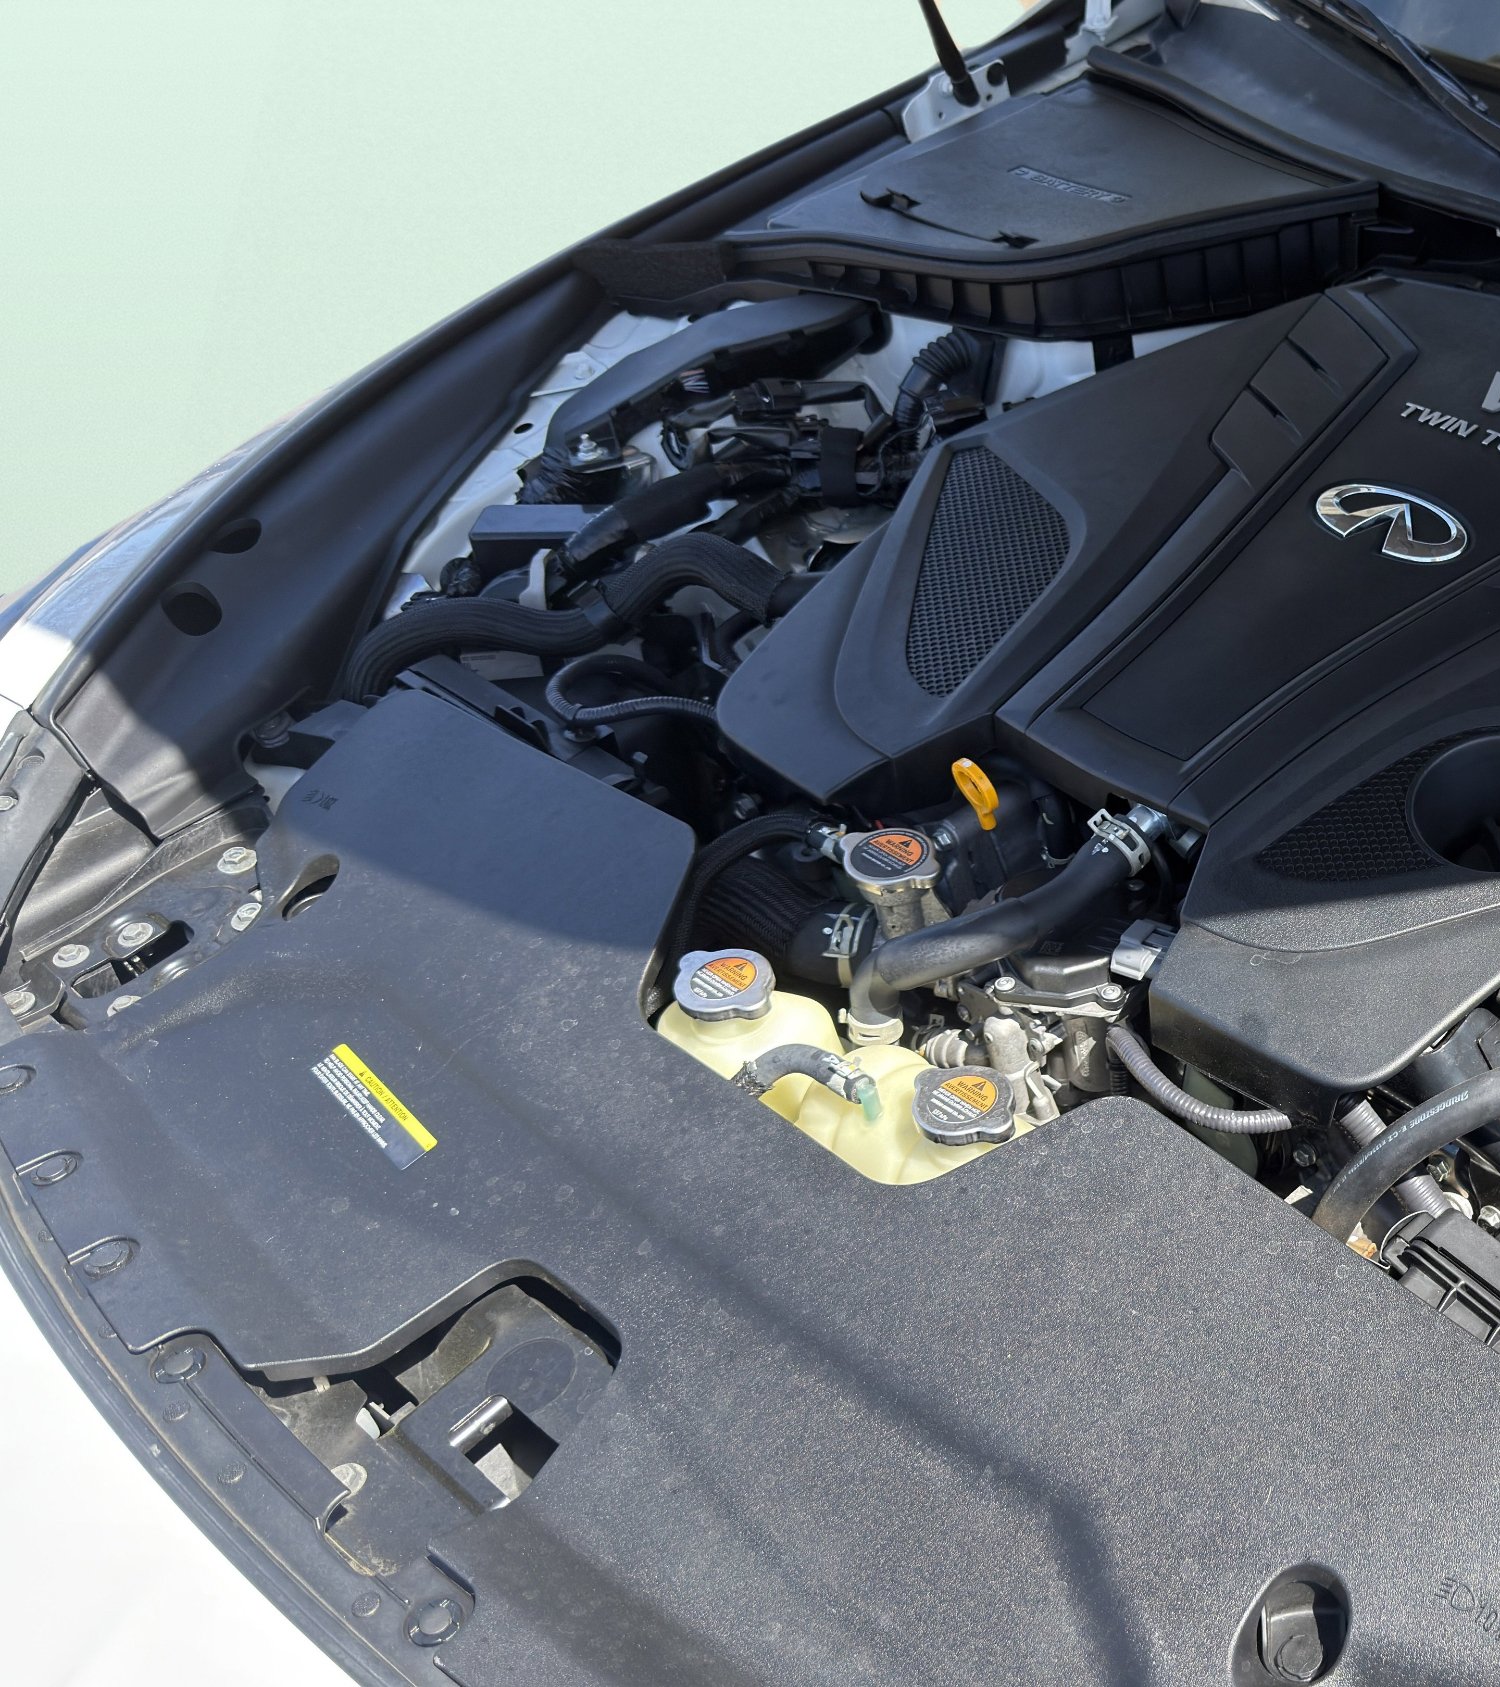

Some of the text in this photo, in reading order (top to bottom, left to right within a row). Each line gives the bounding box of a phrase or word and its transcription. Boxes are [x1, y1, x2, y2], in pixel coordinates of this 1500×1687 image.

[1031, 174, 1108, 200] BATTERY
[1400, 402, 1480, 438] TWIN
[872, 839, 914, 863] AVERTISSEMENT
[885, 838, 913, 856] WARNING
[720, 962, 747, 980] WARNING
[364, 1075, 385, 1096] CAUTION
[384, 1096, 408, 1121] ATTENTION
[945, 1083, 988, 1109] AVERTISSEMENT
[957, 1081, 988, 1101] WARNING
[1409, 1090, 1469, 1128] BRIDGESTONE
